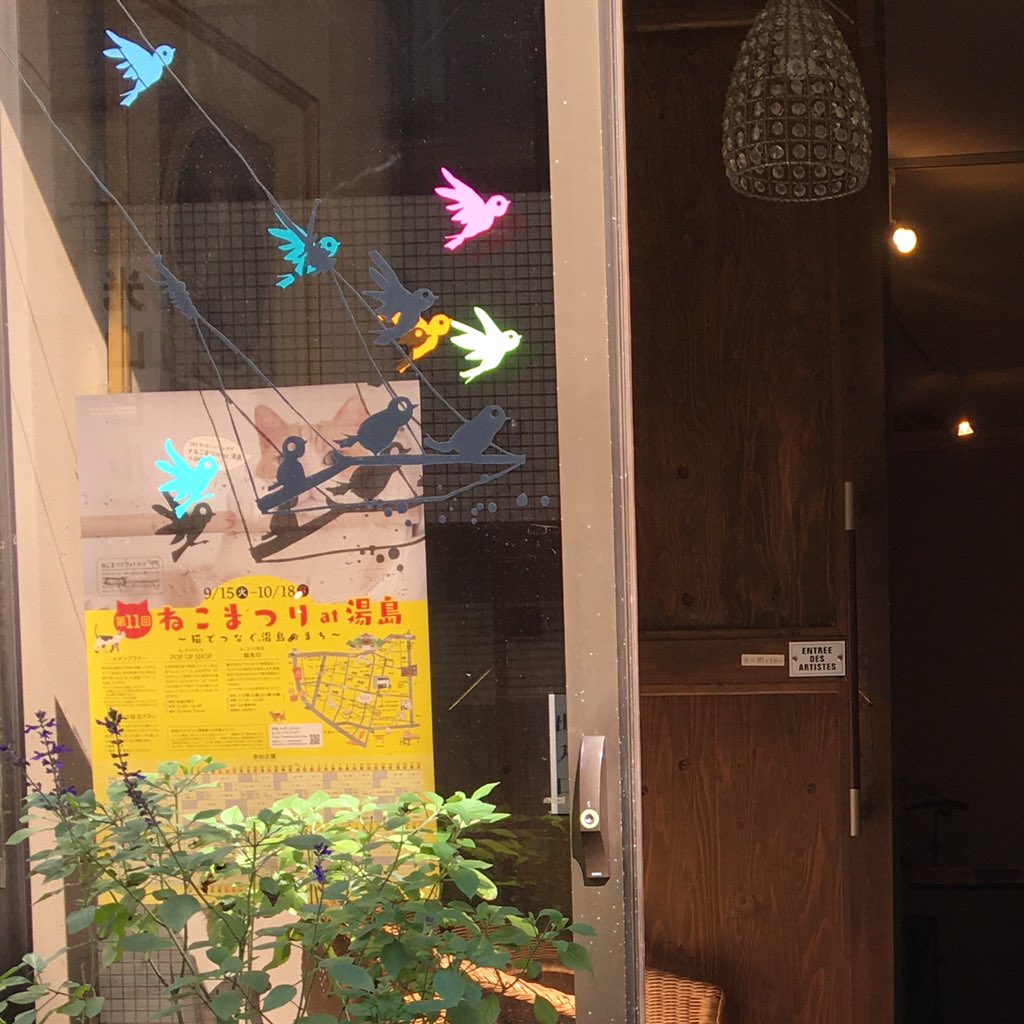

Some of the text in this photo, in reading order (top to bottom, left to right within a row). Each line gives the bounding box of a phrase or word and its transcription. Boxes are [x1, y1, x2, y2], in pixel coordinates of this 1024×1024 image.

[157, 596, 402, 632] ねこまつり at 湯島
[801, 647, 833, 655] ENTREE
[809, 655, 825, 663] DES
[798, 663, 837, 672] ARTISTES
